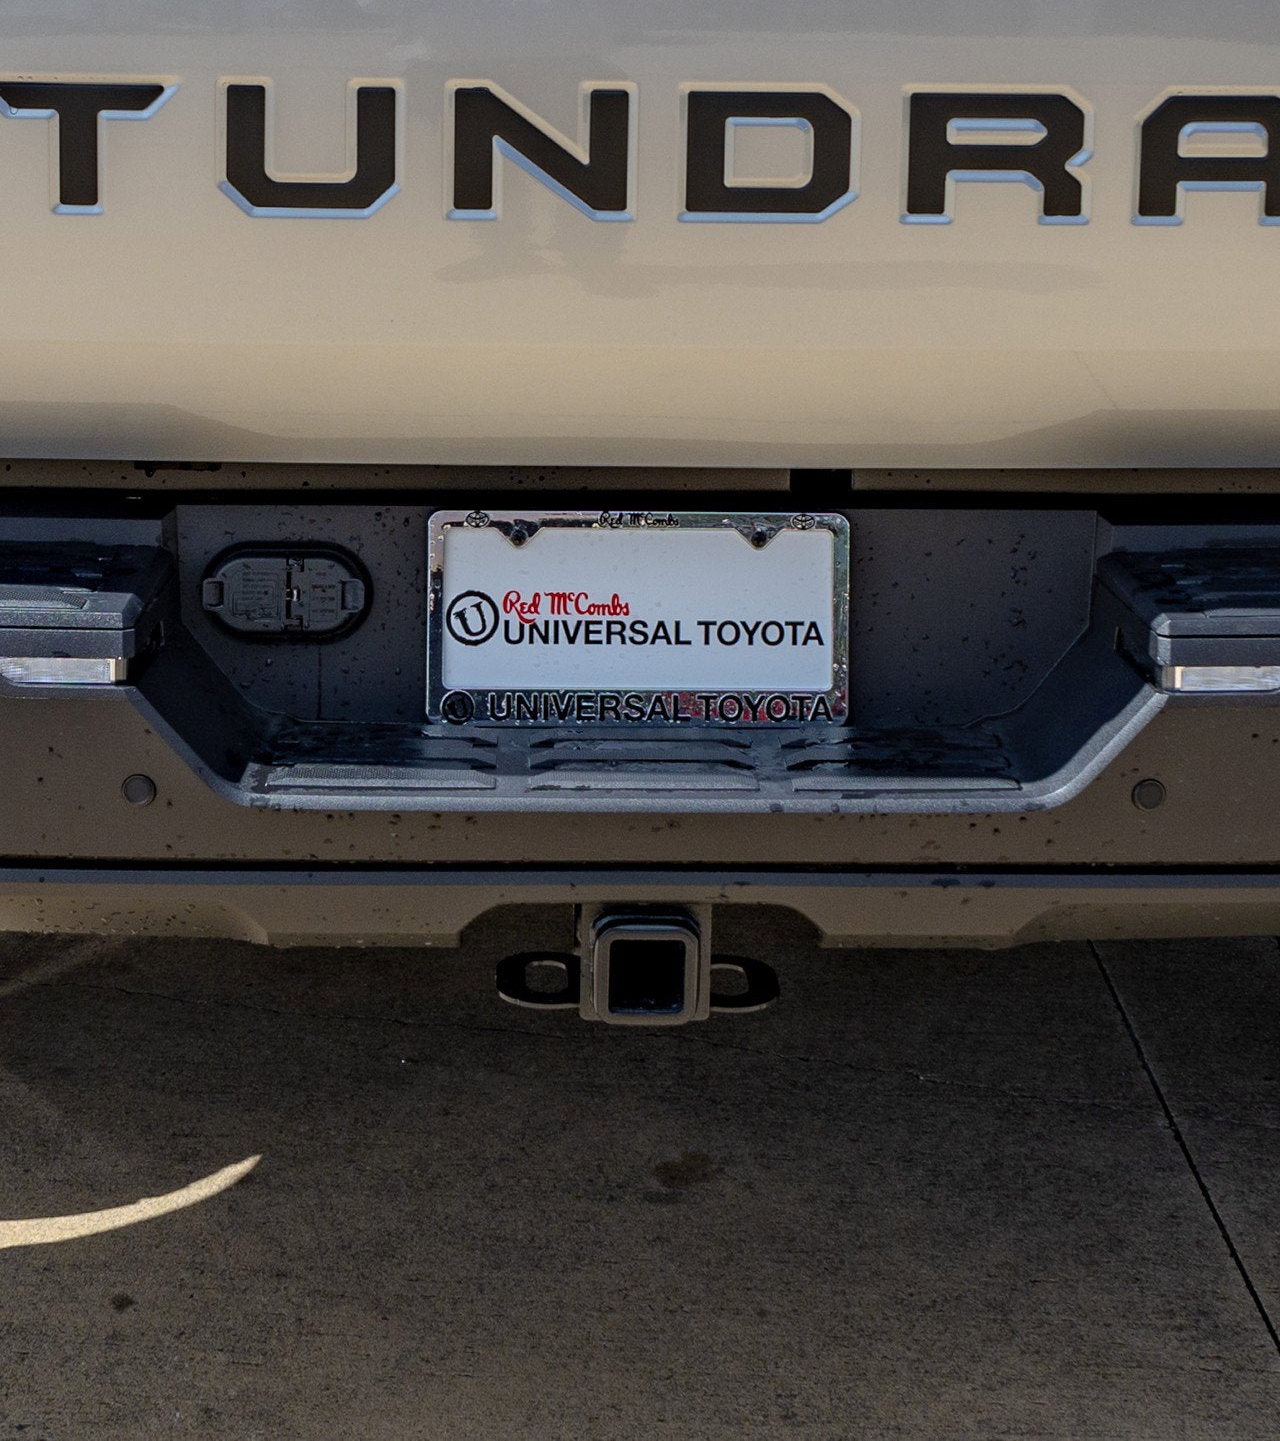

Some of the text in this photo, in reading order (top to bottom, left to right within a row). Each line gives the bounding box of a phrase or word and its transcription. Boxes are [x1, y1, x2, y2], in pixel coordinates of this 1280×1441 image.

[598, 510, 624, 528] Red
[503, 590, 540, 624] Red
[503, 619, 825, 646] UNIVERSAL TOYOTA
[488, 691, 693, 723] UNIVERSAL
[702, 693, 834, 723] TOYOTA
